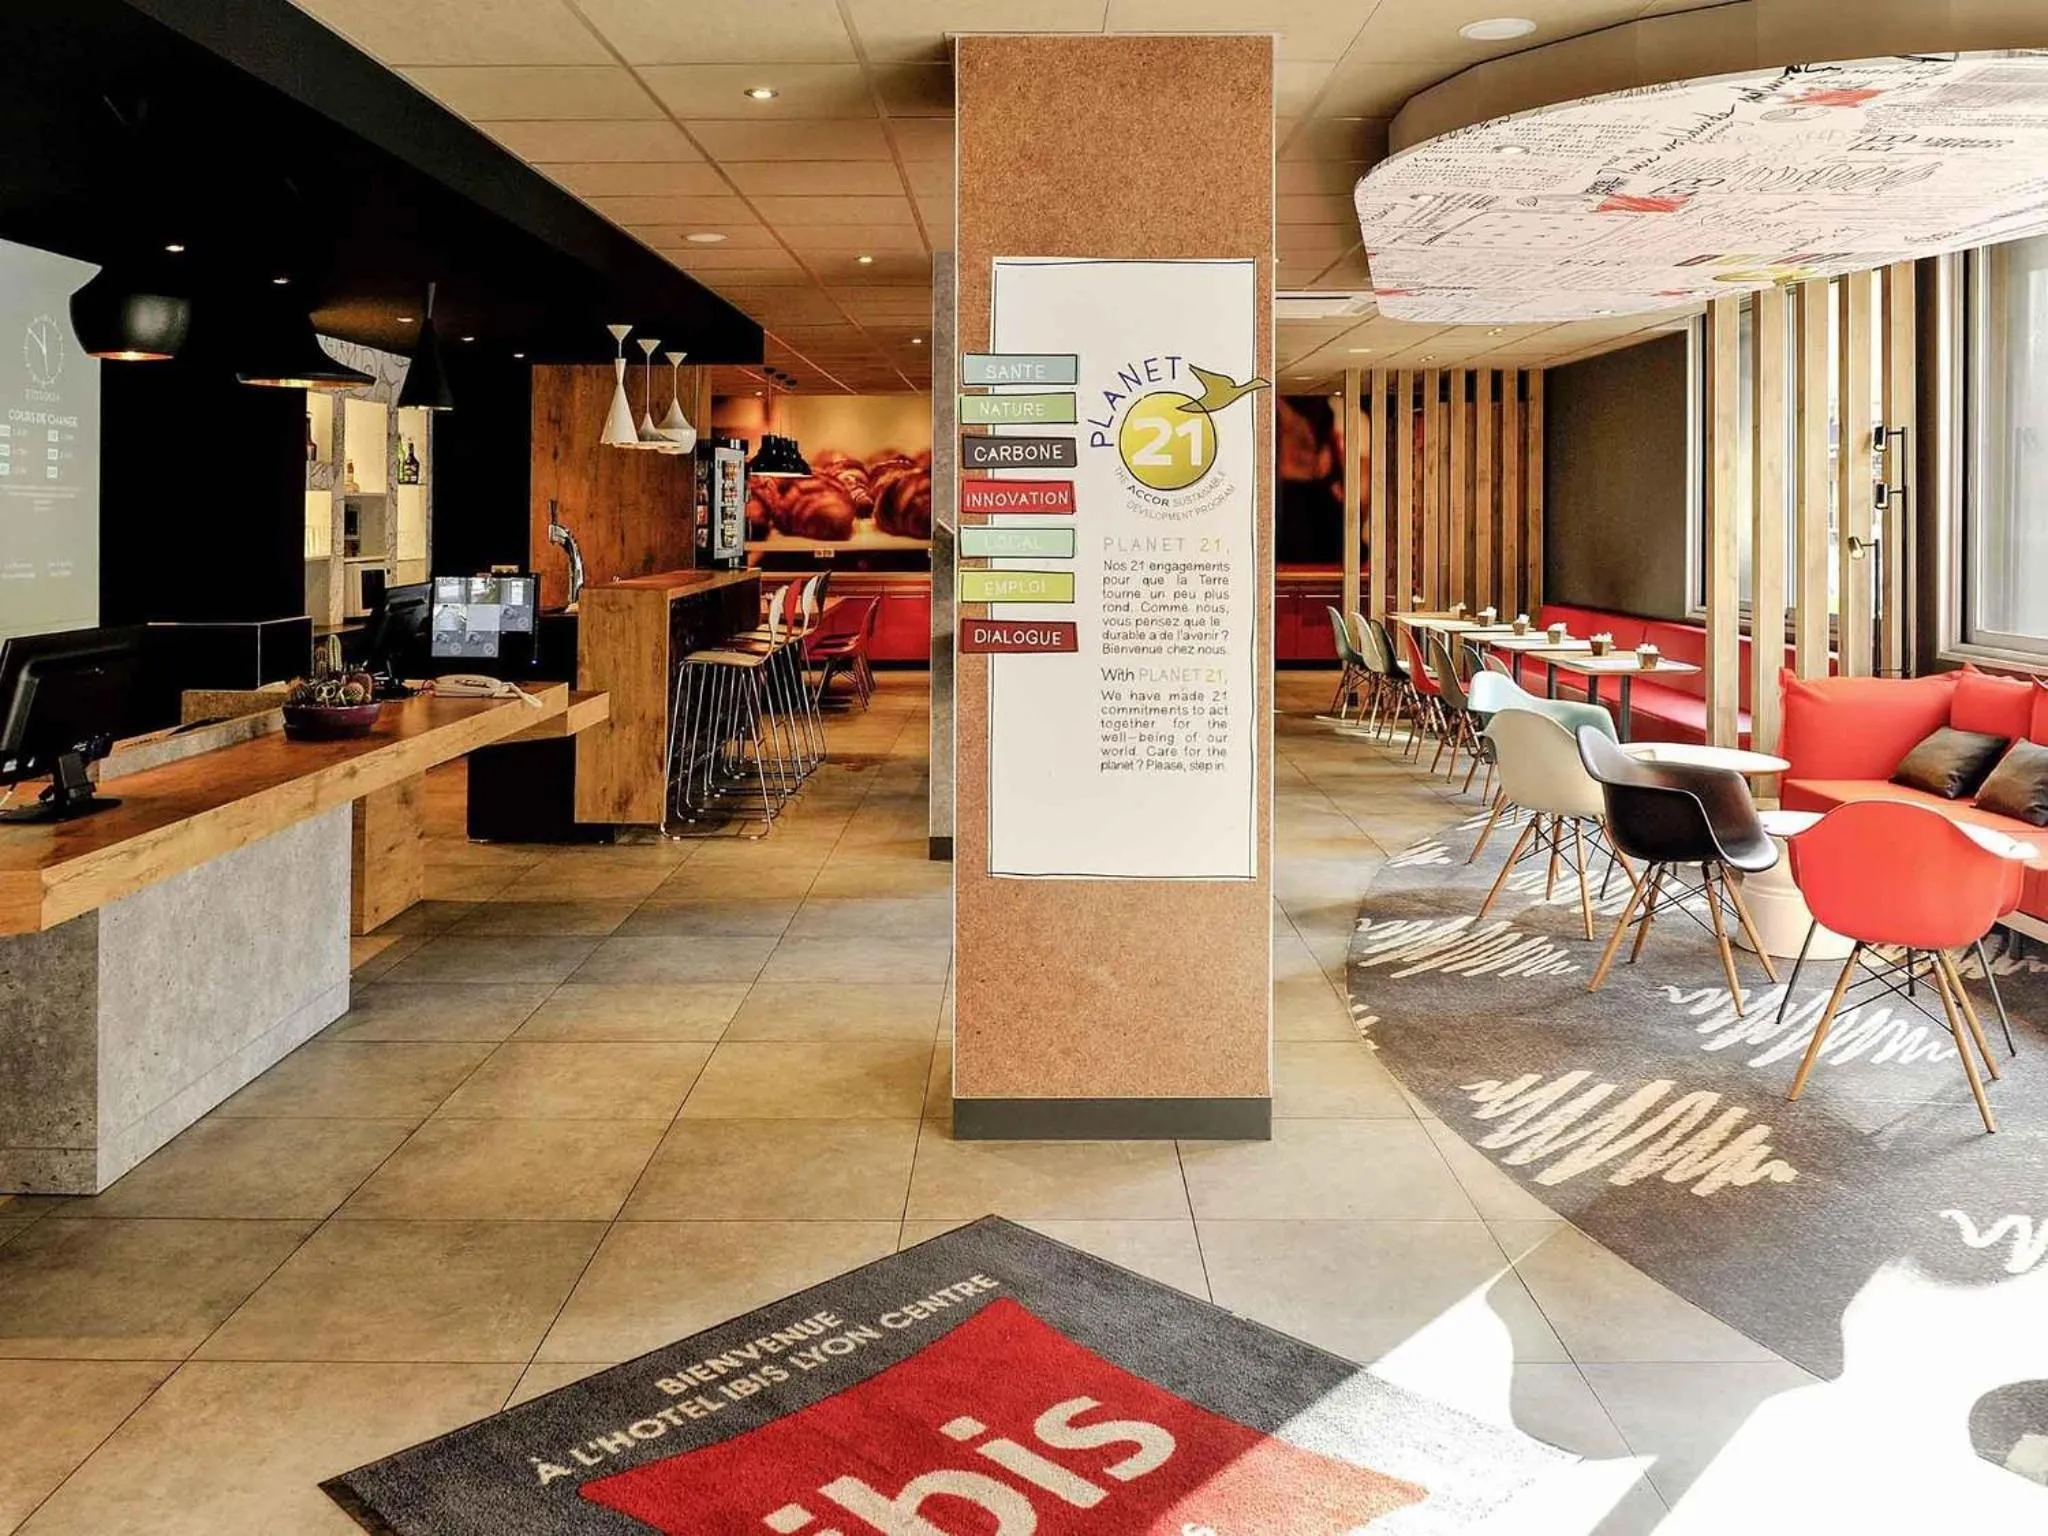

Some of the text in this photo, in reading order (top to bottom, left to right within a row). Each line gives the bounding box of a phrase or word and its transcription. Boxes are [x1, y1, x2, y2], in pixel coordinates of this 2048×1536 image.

[979, 402, 1045, 416] NATURE
[1088, 356, 1181, 448] PLANET
[1132, 417, 1201, 466] 21
[974, 444, 1063, 461] CARBONE
[1128, 485, 1169, 506] ACCOR
[1172, 471, 1227, 507] SUSTAINABLE
[966, 492, 1069, 507] INNOVATION
[1126, 484, 1235, 521] DEVELOPMENT PROGRAM
[984, 533, 1042, 550] LOCAL
[1103, 538, 1185, 552] PLANET
[1103, 561, 1230, 574] Nos 21 engagements
[1103, 574, 1229, 588] pour que la Terre
[985, 581, 1047, 596] EMPLOI
[1103, 589, 1229, 602] tourne un peu plus
[1140, 603, 1188, 613] Comme
[1196, 605, 1230, 615] nous,
[1103, 616, 1220, 630] vous pensez que le
[975, 629, 1061, 645] DIALOGUE
[1103, 630, 1228, 640] durable a de l'avenir ?
[1102, 643, 1163, 654] Bienvenue
[1166, 643, 1194, 654] chez
[1102, 668, 1134, 682] With
[1139, 669, 1200, 681] PLANET
[1101, 690, 1227, 701] We have made 21
[1101, 705, 1228, 715] commitments to act
[1101, 718, 1227, 732] together for the
[1101, 732, 1227, 745] well-being of our
[1147, 746, 1177, 757] Care
[1184, 746, 1200, 757] for
[1207, 746, 1227, 757] the
[1101, 759, 1134, 771] planet
[1136, 760, 1143, 770] ?
[1147, 760, 1186, 772] Please,
[1189, 760, 1212, 772] step
[654, 1311, 844, 1398] BIENVENUE
[530, 1273, 1000, 1486] À L'HOTEL IBIS LYON CENTRE
